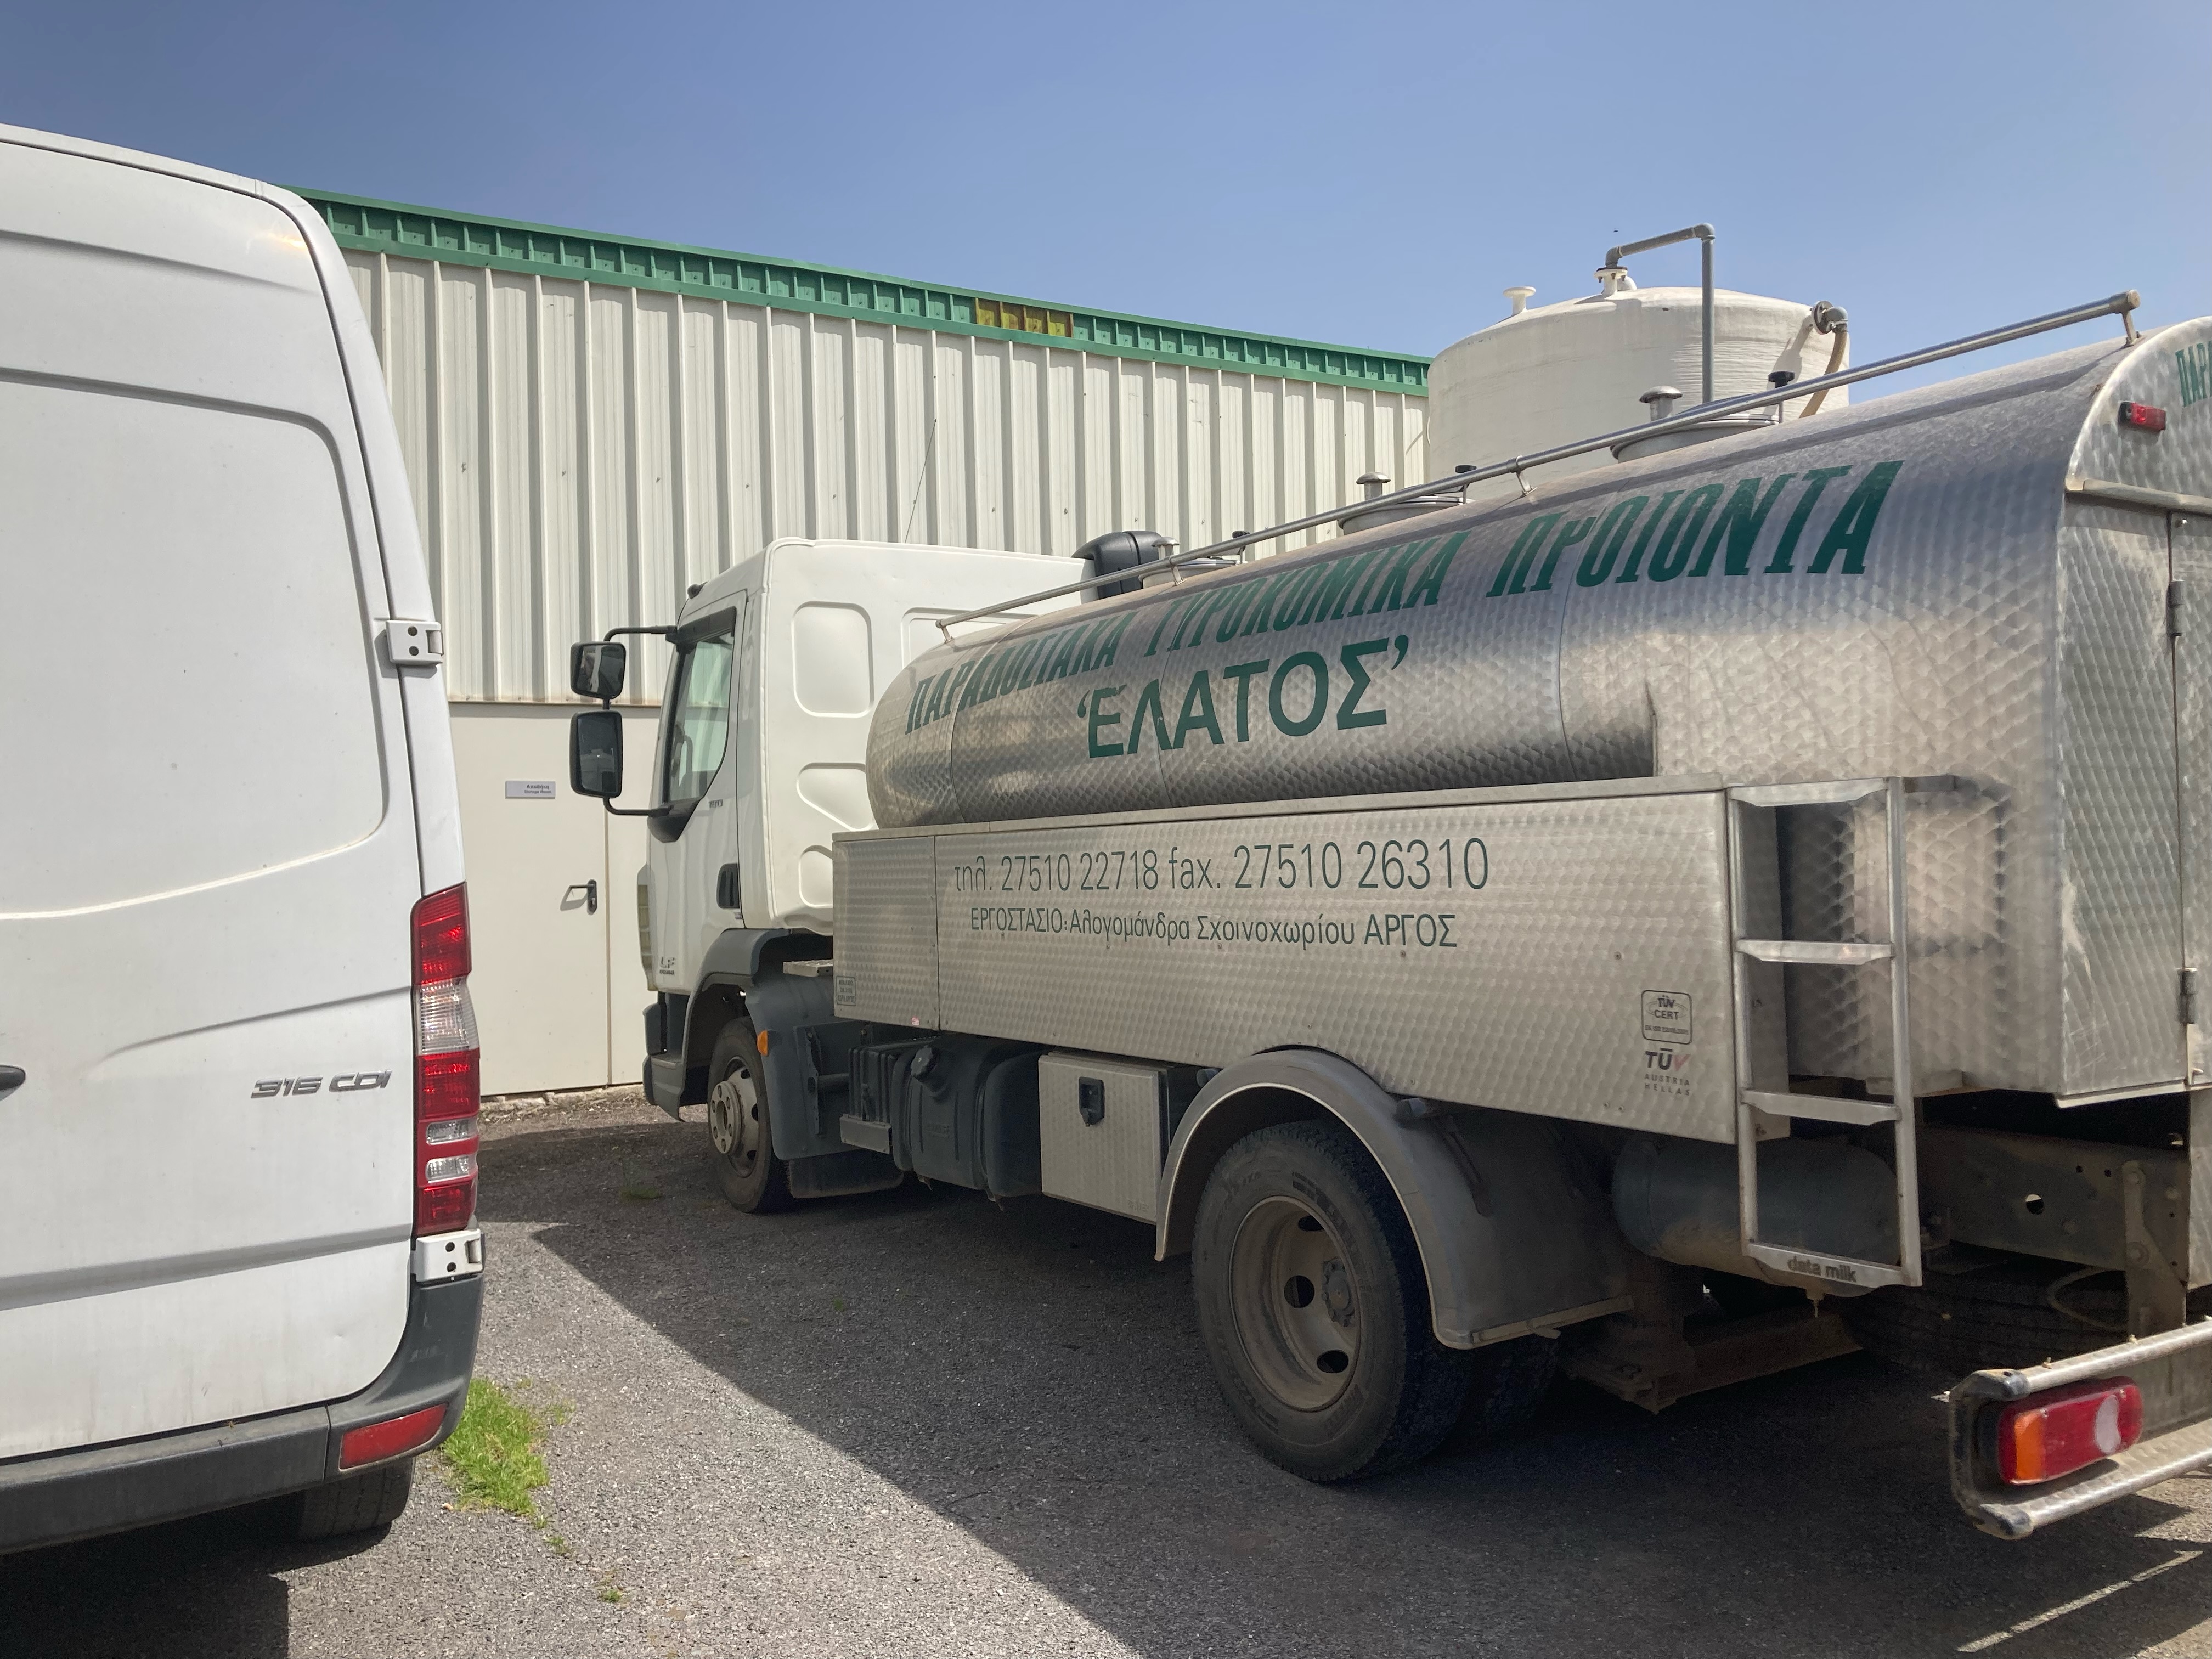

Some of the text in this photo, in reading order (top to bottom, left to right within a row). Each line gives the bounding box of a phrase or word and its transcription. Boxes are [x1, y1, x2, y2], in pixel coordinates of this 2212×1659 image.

[2175, 341, 2212, 407] ΠΑΡ
[905, 460, 1904, 735] ΠΑΡΑΔΟΣΙΑΚΑ ΤΥΡΟΚΟΜΙΚΑ ΠΡΟΙΟΝΤΑ
[955, 838, 1489, 891] τηλ. 27510 22718 fax. 27510 26310
[1197, 913, 1355, 950] Σχοινοχωρίου
[1364, 913, 1457, 947] ΑΡΓΟΣ
[1654, 1009, 1679, 1020] CERT
[250, 1069, 393, 1099] 316 CDI
[1644, 1073, 1690, 1086] AUSTRIA
[1645, 1082, 1690, 1096] HELLAS
[1787, 1256, 1857, 1283] data milk
